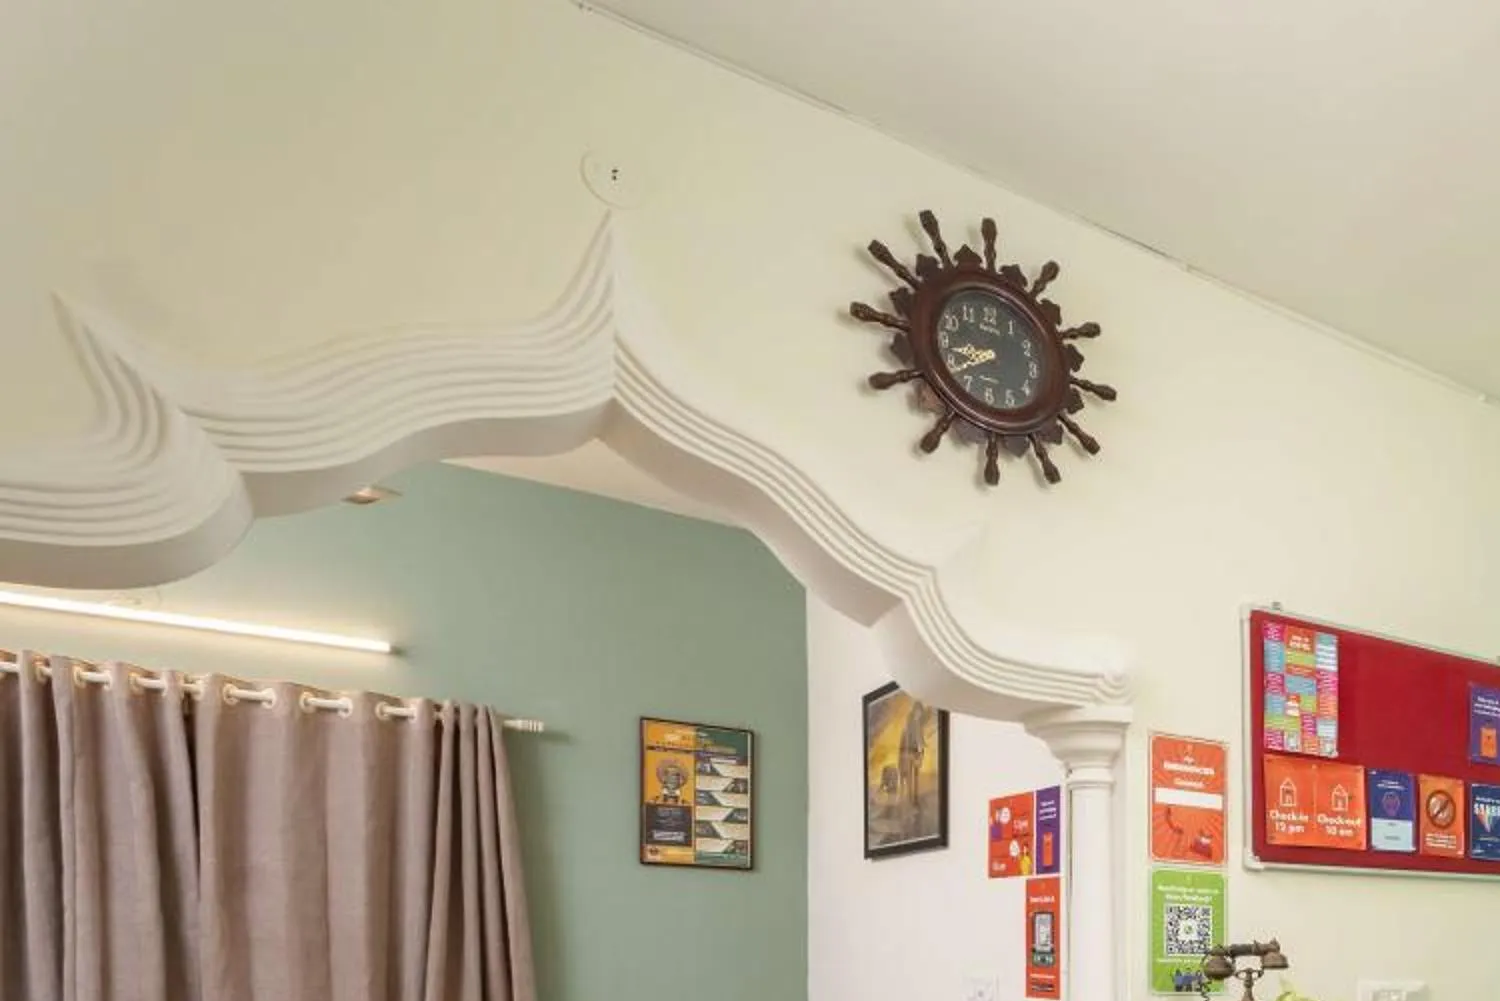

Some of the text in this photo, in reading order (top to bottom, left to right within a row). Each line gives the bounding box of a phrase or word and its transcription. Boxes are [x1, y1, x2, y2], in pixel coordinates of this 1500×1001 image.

[961, 304, 975, 323] 11
[1007, 320, 1015, 336] 1
[1022, 339, 1032, 357] 2
[1029, 361, 1037, 379] 3
[963, 375, 973, 392] 7
[1020, 379, 1032, 398] 4
[984, 387, 994, 405] 6
[1004, 390, 1015, 408] 5
